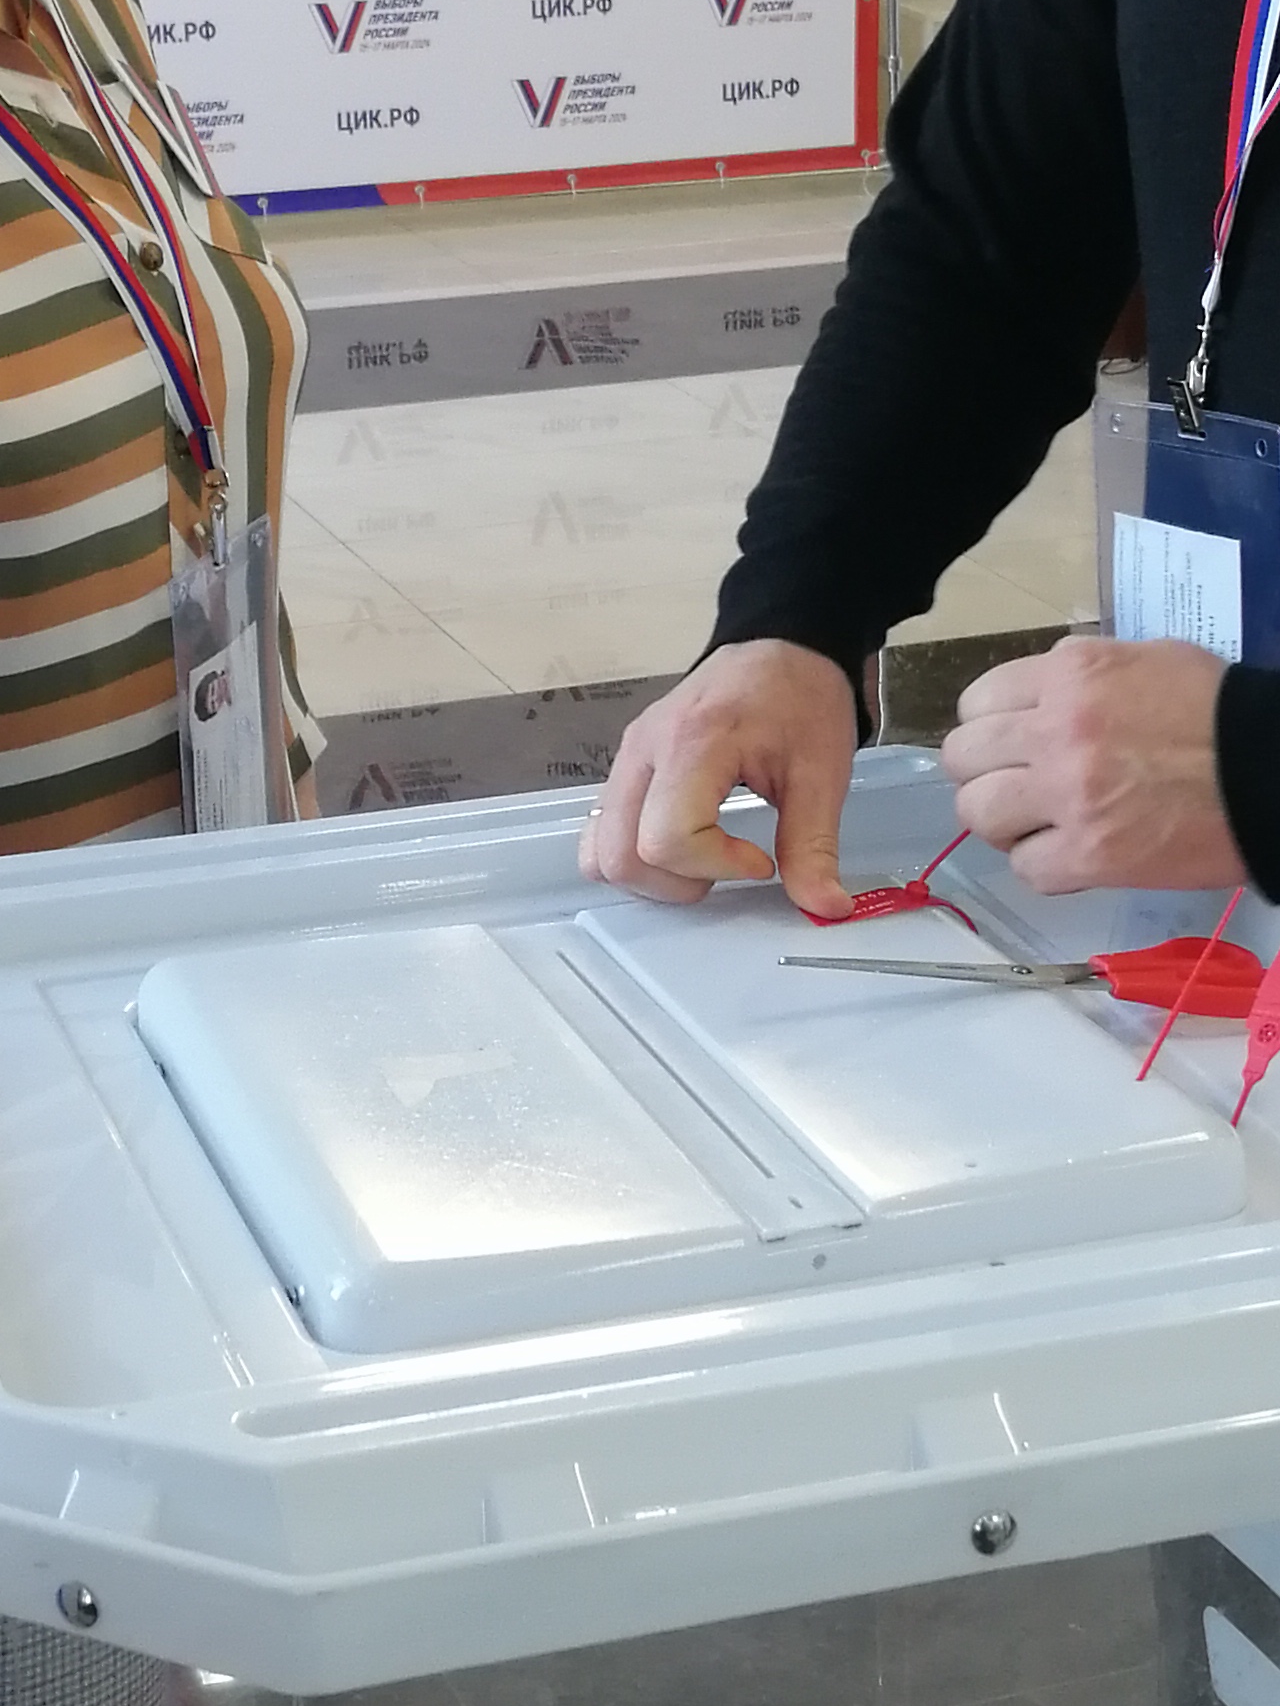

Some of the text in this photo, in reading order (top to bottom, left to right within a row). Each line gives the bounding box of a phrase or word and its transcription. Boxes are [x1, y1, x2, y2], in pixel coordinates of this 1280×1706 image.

[146, 20, 217, 45] ИК.РФ
[722, 77, 800, 105] ЦИК.РФ
[186, 100, 229, 113] ЫБОРЫ
[336, 106, 420, 135] ЦИК.РФ
